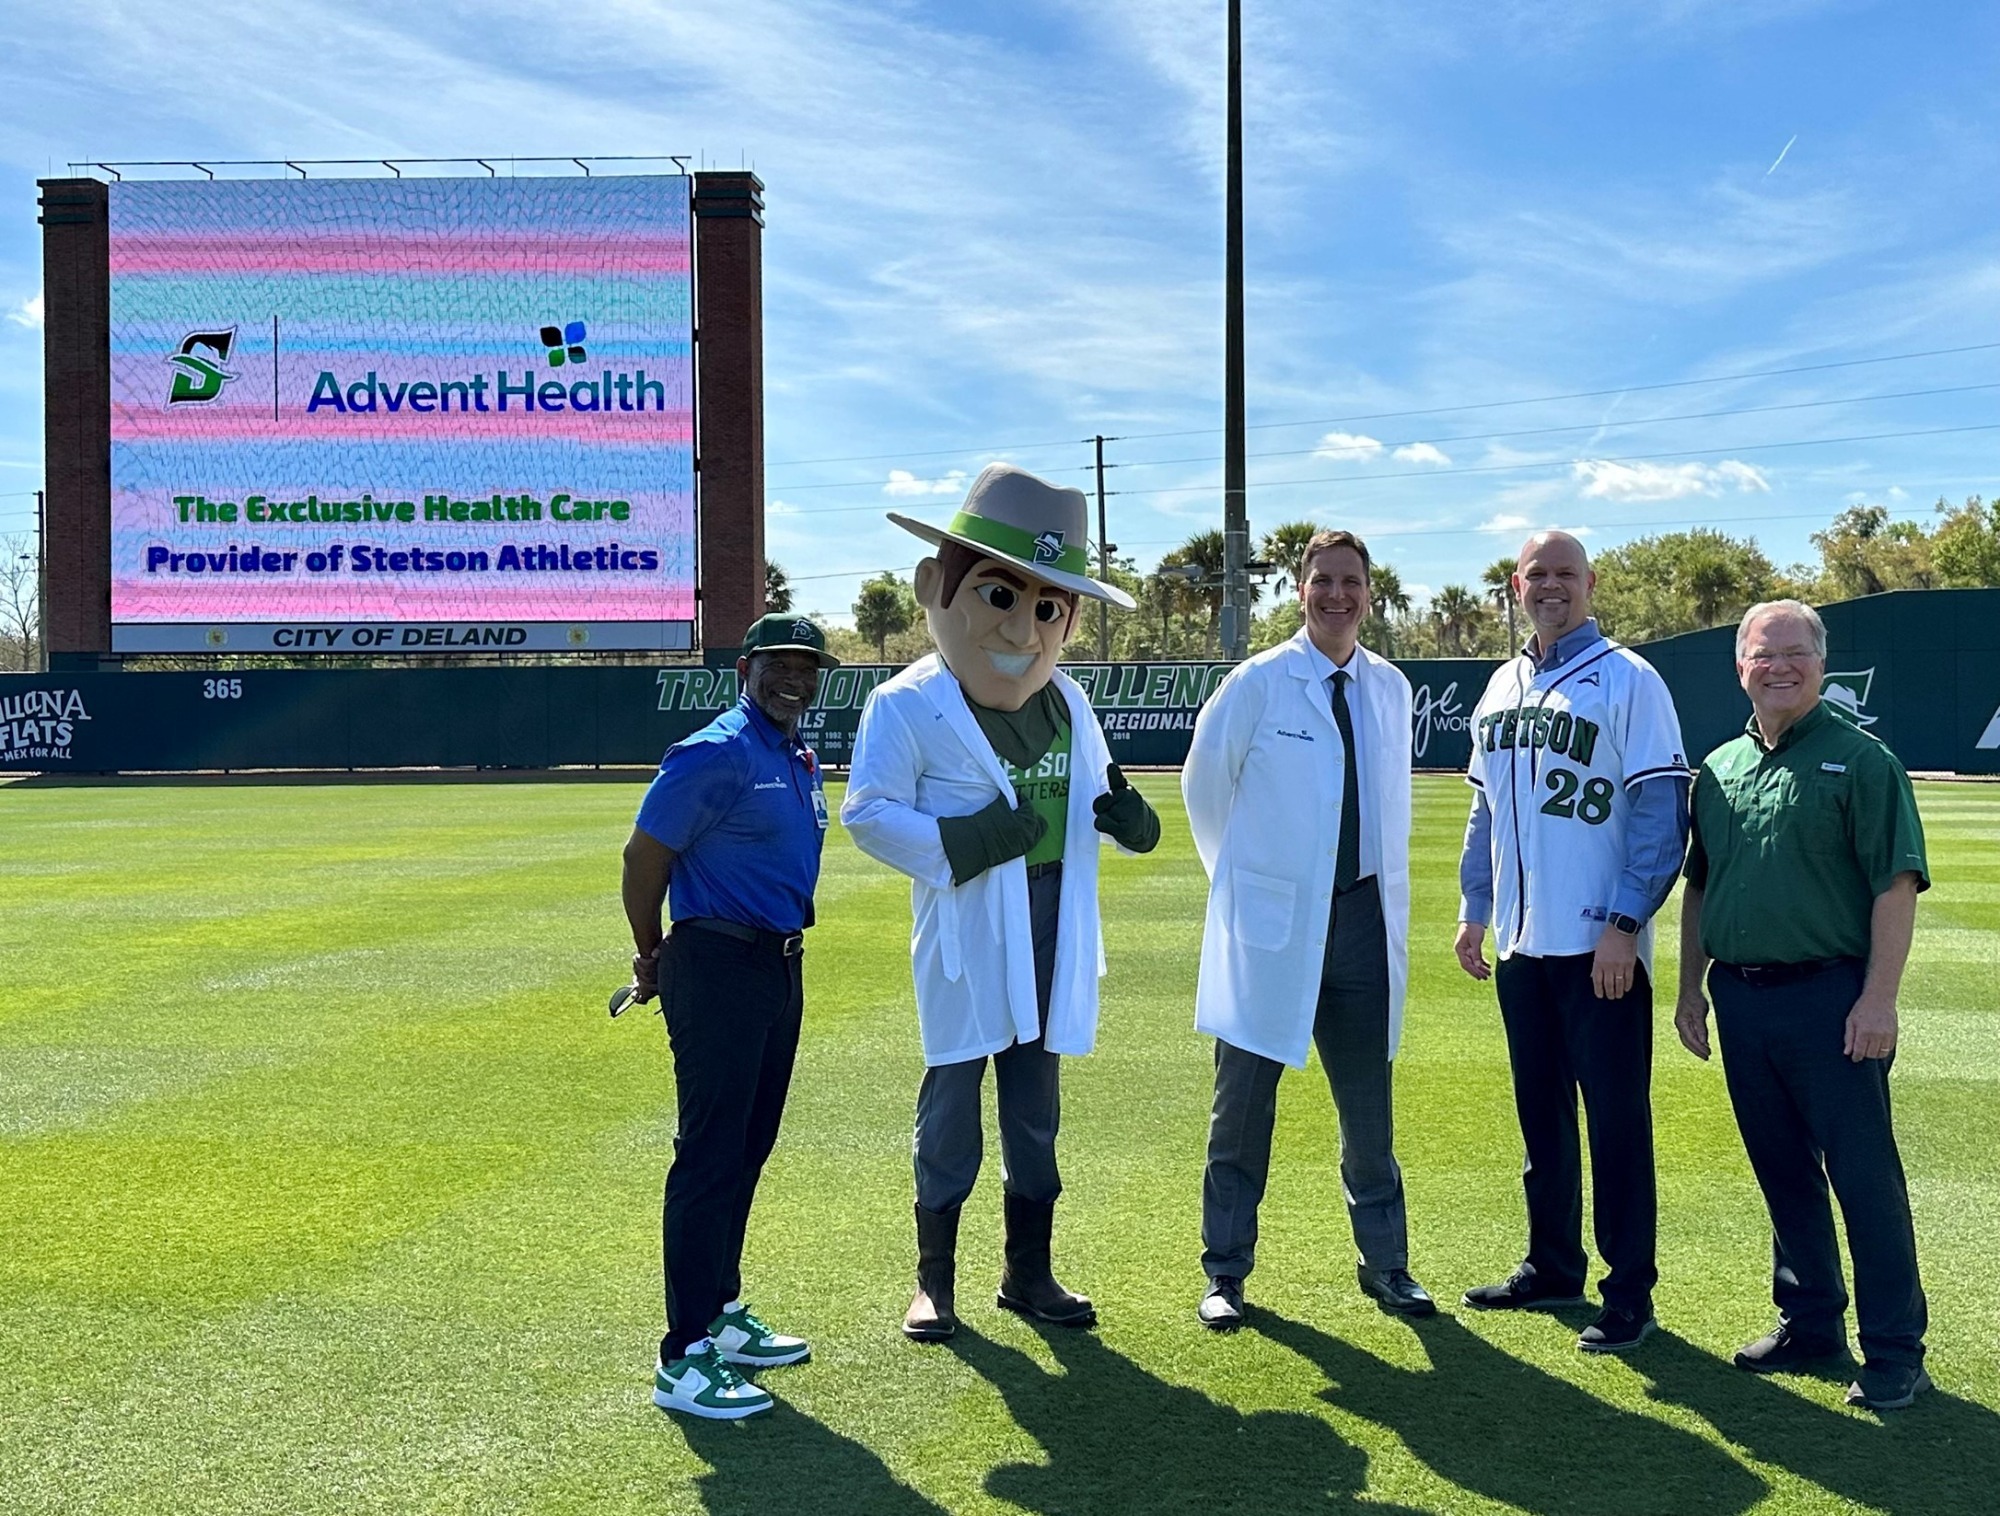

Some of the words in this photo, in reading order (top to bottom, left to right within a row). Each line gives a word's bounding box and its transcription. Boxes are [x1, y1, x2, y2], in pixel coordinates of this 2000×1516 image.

[307, 370, 664, 412] AdventHealth
[174, 496, 237, 522] The
[247, 495, 415, 522] Exclusive
[424, 494, 542, 521] Health
[551, 494, 630, 521] Care
[148, 546, 297, 572] Provider
[306, 545, 344, 572] of
[352, 546, 488, 571] Stetson
[497, 543, 658, 571] Athletics
[273, 629, 342, 646] CITY
[352, 628, 394, 646] OF
[401, 628, 526, 646] DELAND
[203, 679, 242, 699] 365
[1103, 713, 1195, 730] REGIONAL
[1413, 681, 1463, 758] ge
[1433, 716, 1472, 731] WOR
[30, 747, 48, 757] FOR
[51, 747, 72, 759] ALL
[1540, 768, 1614, 825] 28
